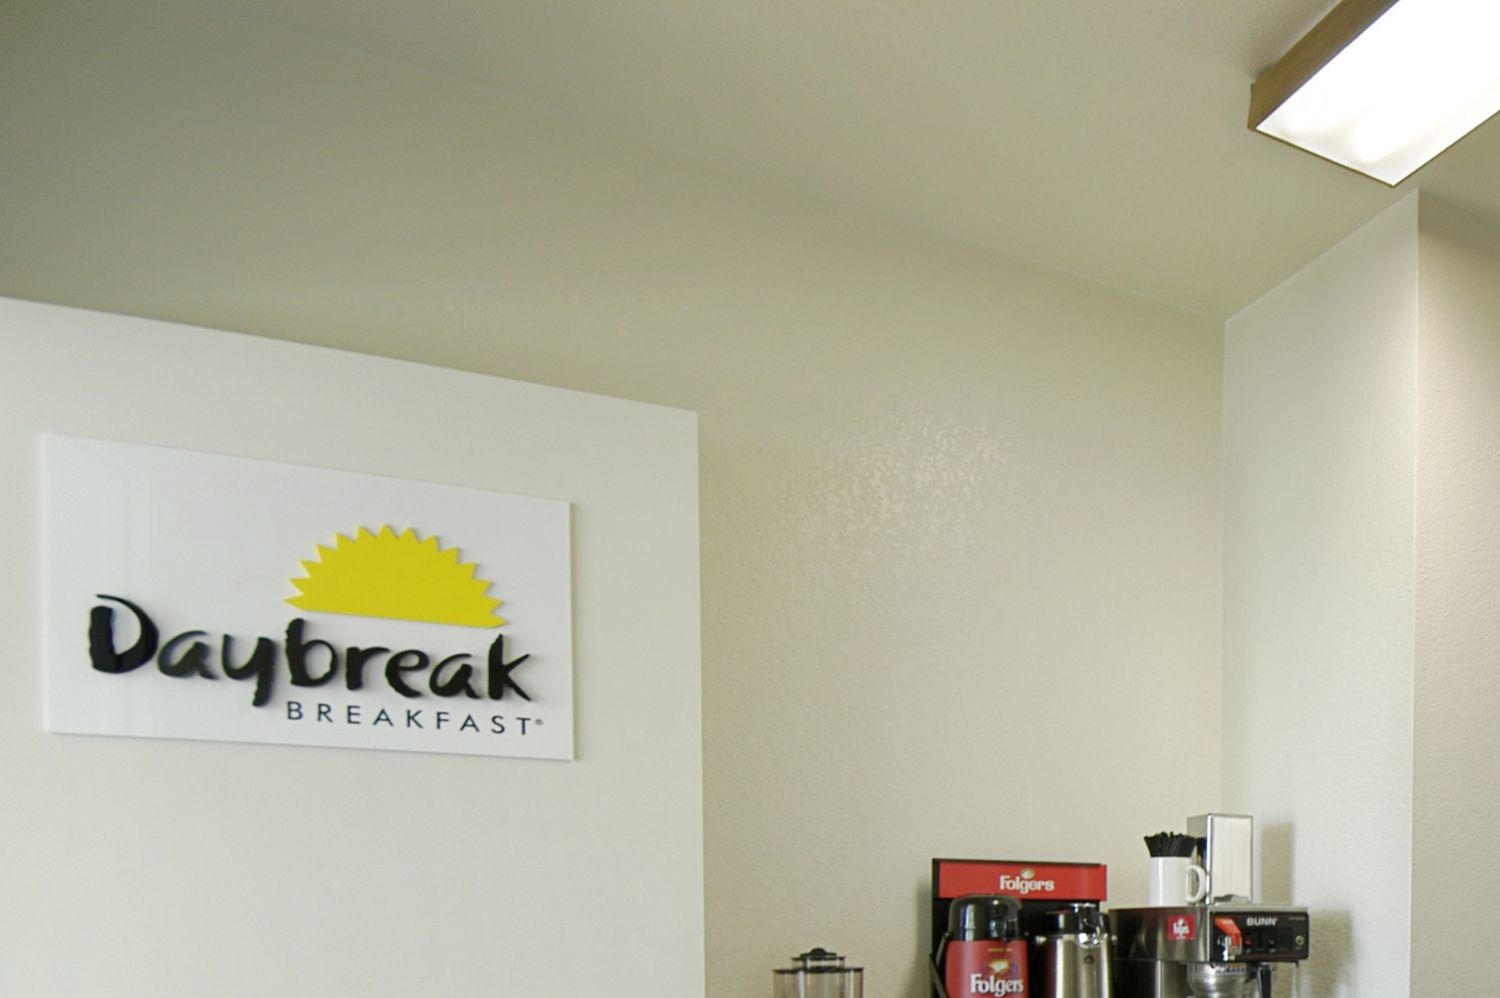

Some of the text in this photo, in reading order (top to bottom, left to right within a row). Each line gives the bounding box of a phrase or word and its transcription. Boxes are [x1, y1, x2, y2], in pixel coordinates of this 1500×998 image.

[88, 594, 532, 707] Daybreak
[287, 700, 532, 736] BREAKFAST
[999, 875, 1056, 894] Folgers
[1246, 917, 1276, 926] BUNN
[970, 973, 1024, 997] Folgers
